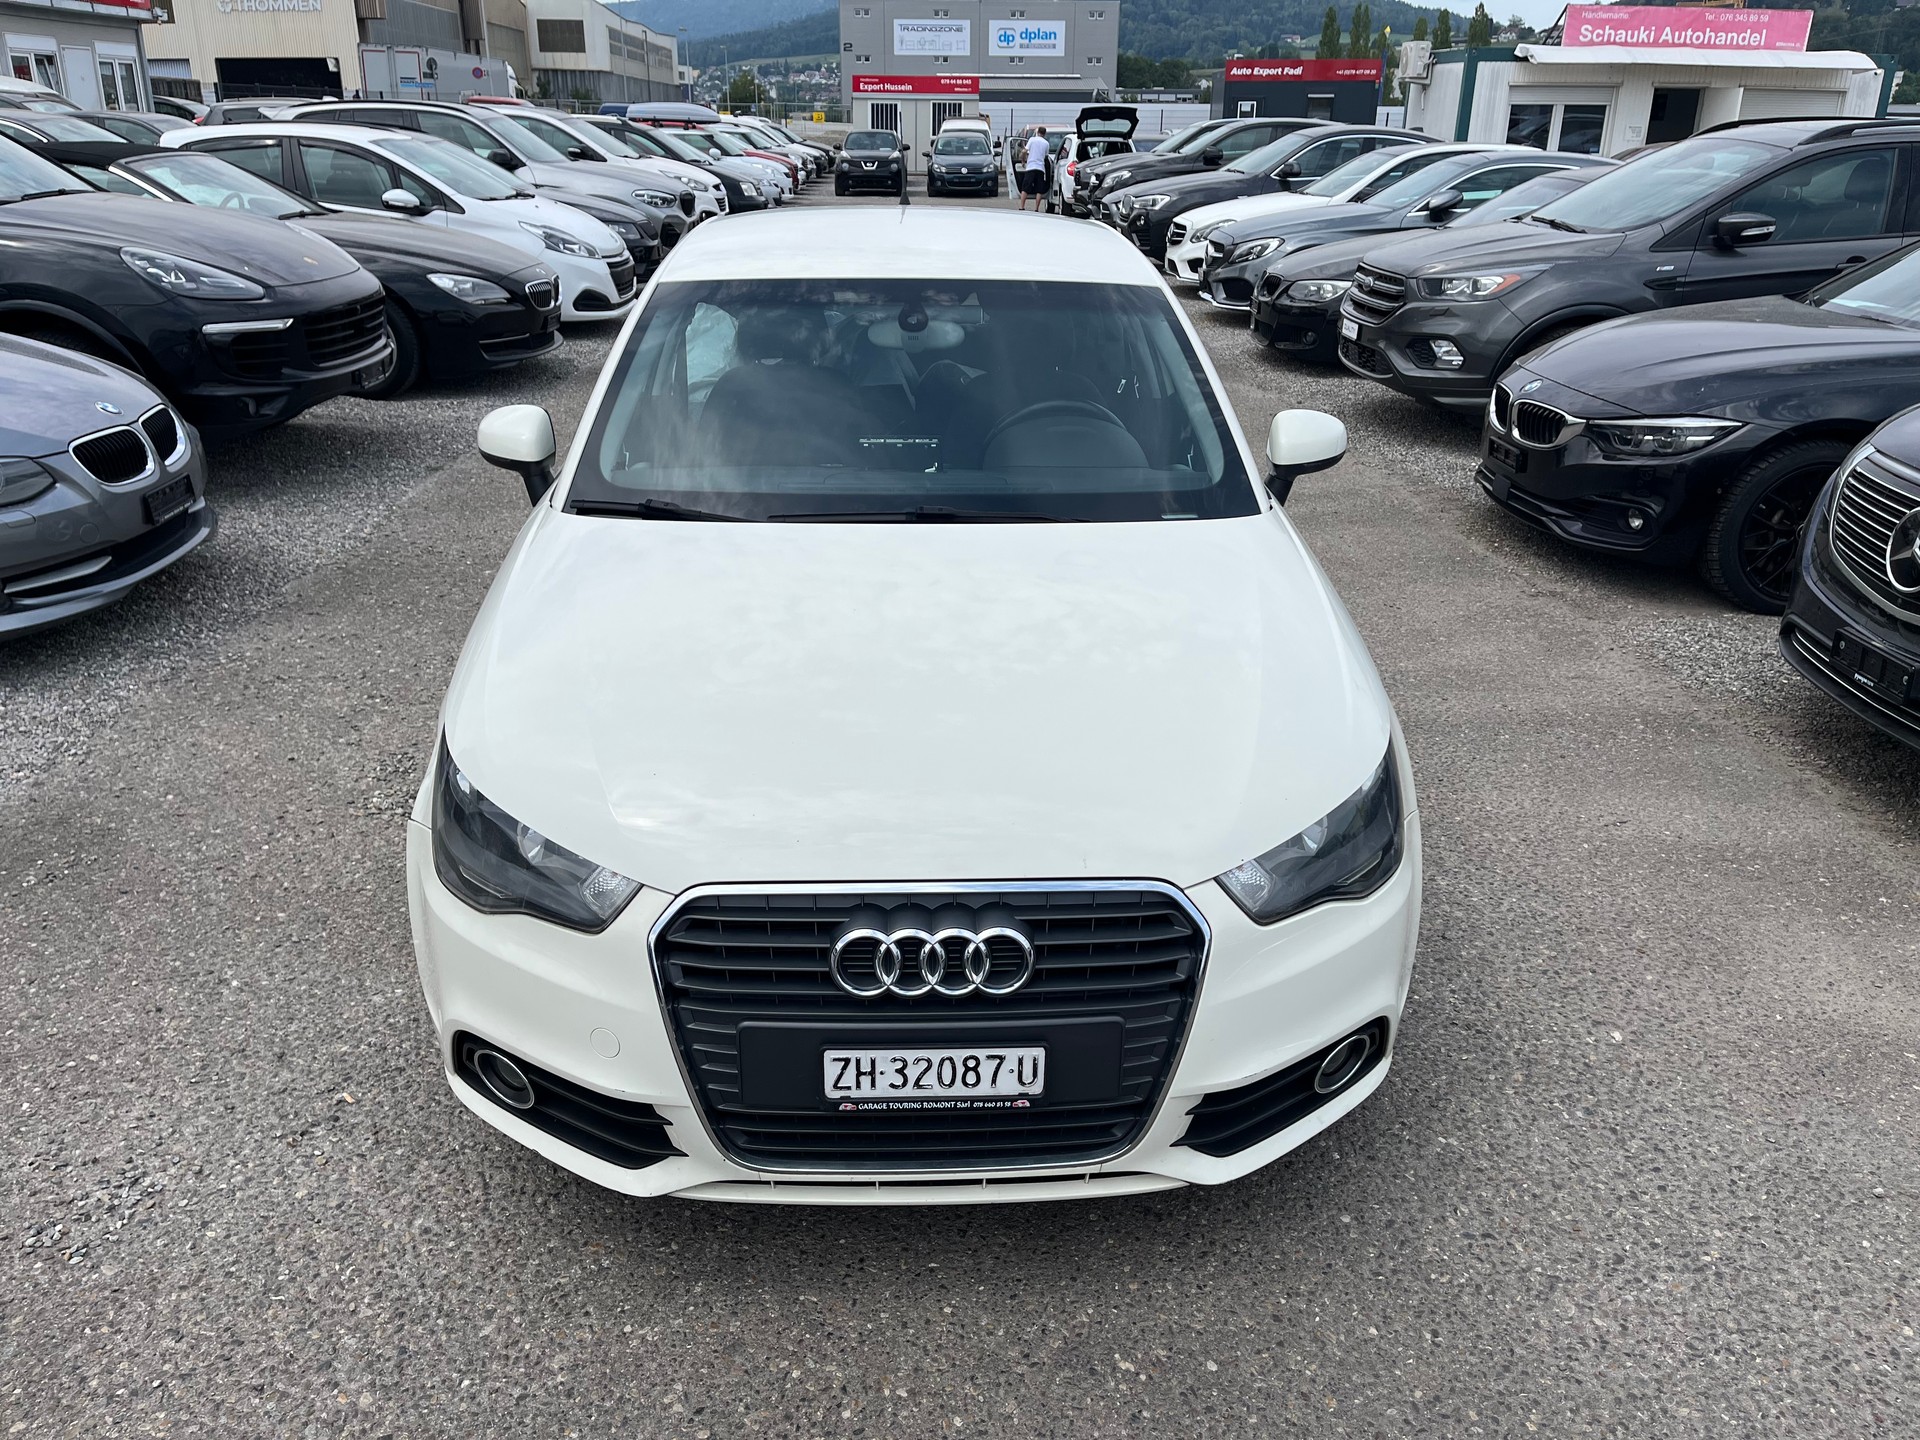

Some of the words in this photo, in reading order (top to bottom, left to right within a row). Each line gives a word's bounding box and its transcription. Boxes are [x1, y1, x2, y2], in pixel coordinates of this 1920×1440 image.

[1720, 13, 1733, 21] 076
[1749, 14, 1758, 22] 89
[1760, 14, 1769, 22] 59
[998, 31, 1015, 45] dp
[1020, 27, 1057, 43] dplan
[1579, 25, 1655, 43] Schauki
[1659, 26, 1766, 46] Autohandel
[843, 42, 853, 52] 2
[1230, 67, 1252, 75] Auto
[1253, 67, 1282, 77] Export
[1283, 66, 1303, 75] Fadi
[860, 82, 884, 91] Export
[885, 82, 913, 91] Hussein
[858, 1102, 887, 1110] GARAGE
[923, 1101, 955, 1109] ROMONT
